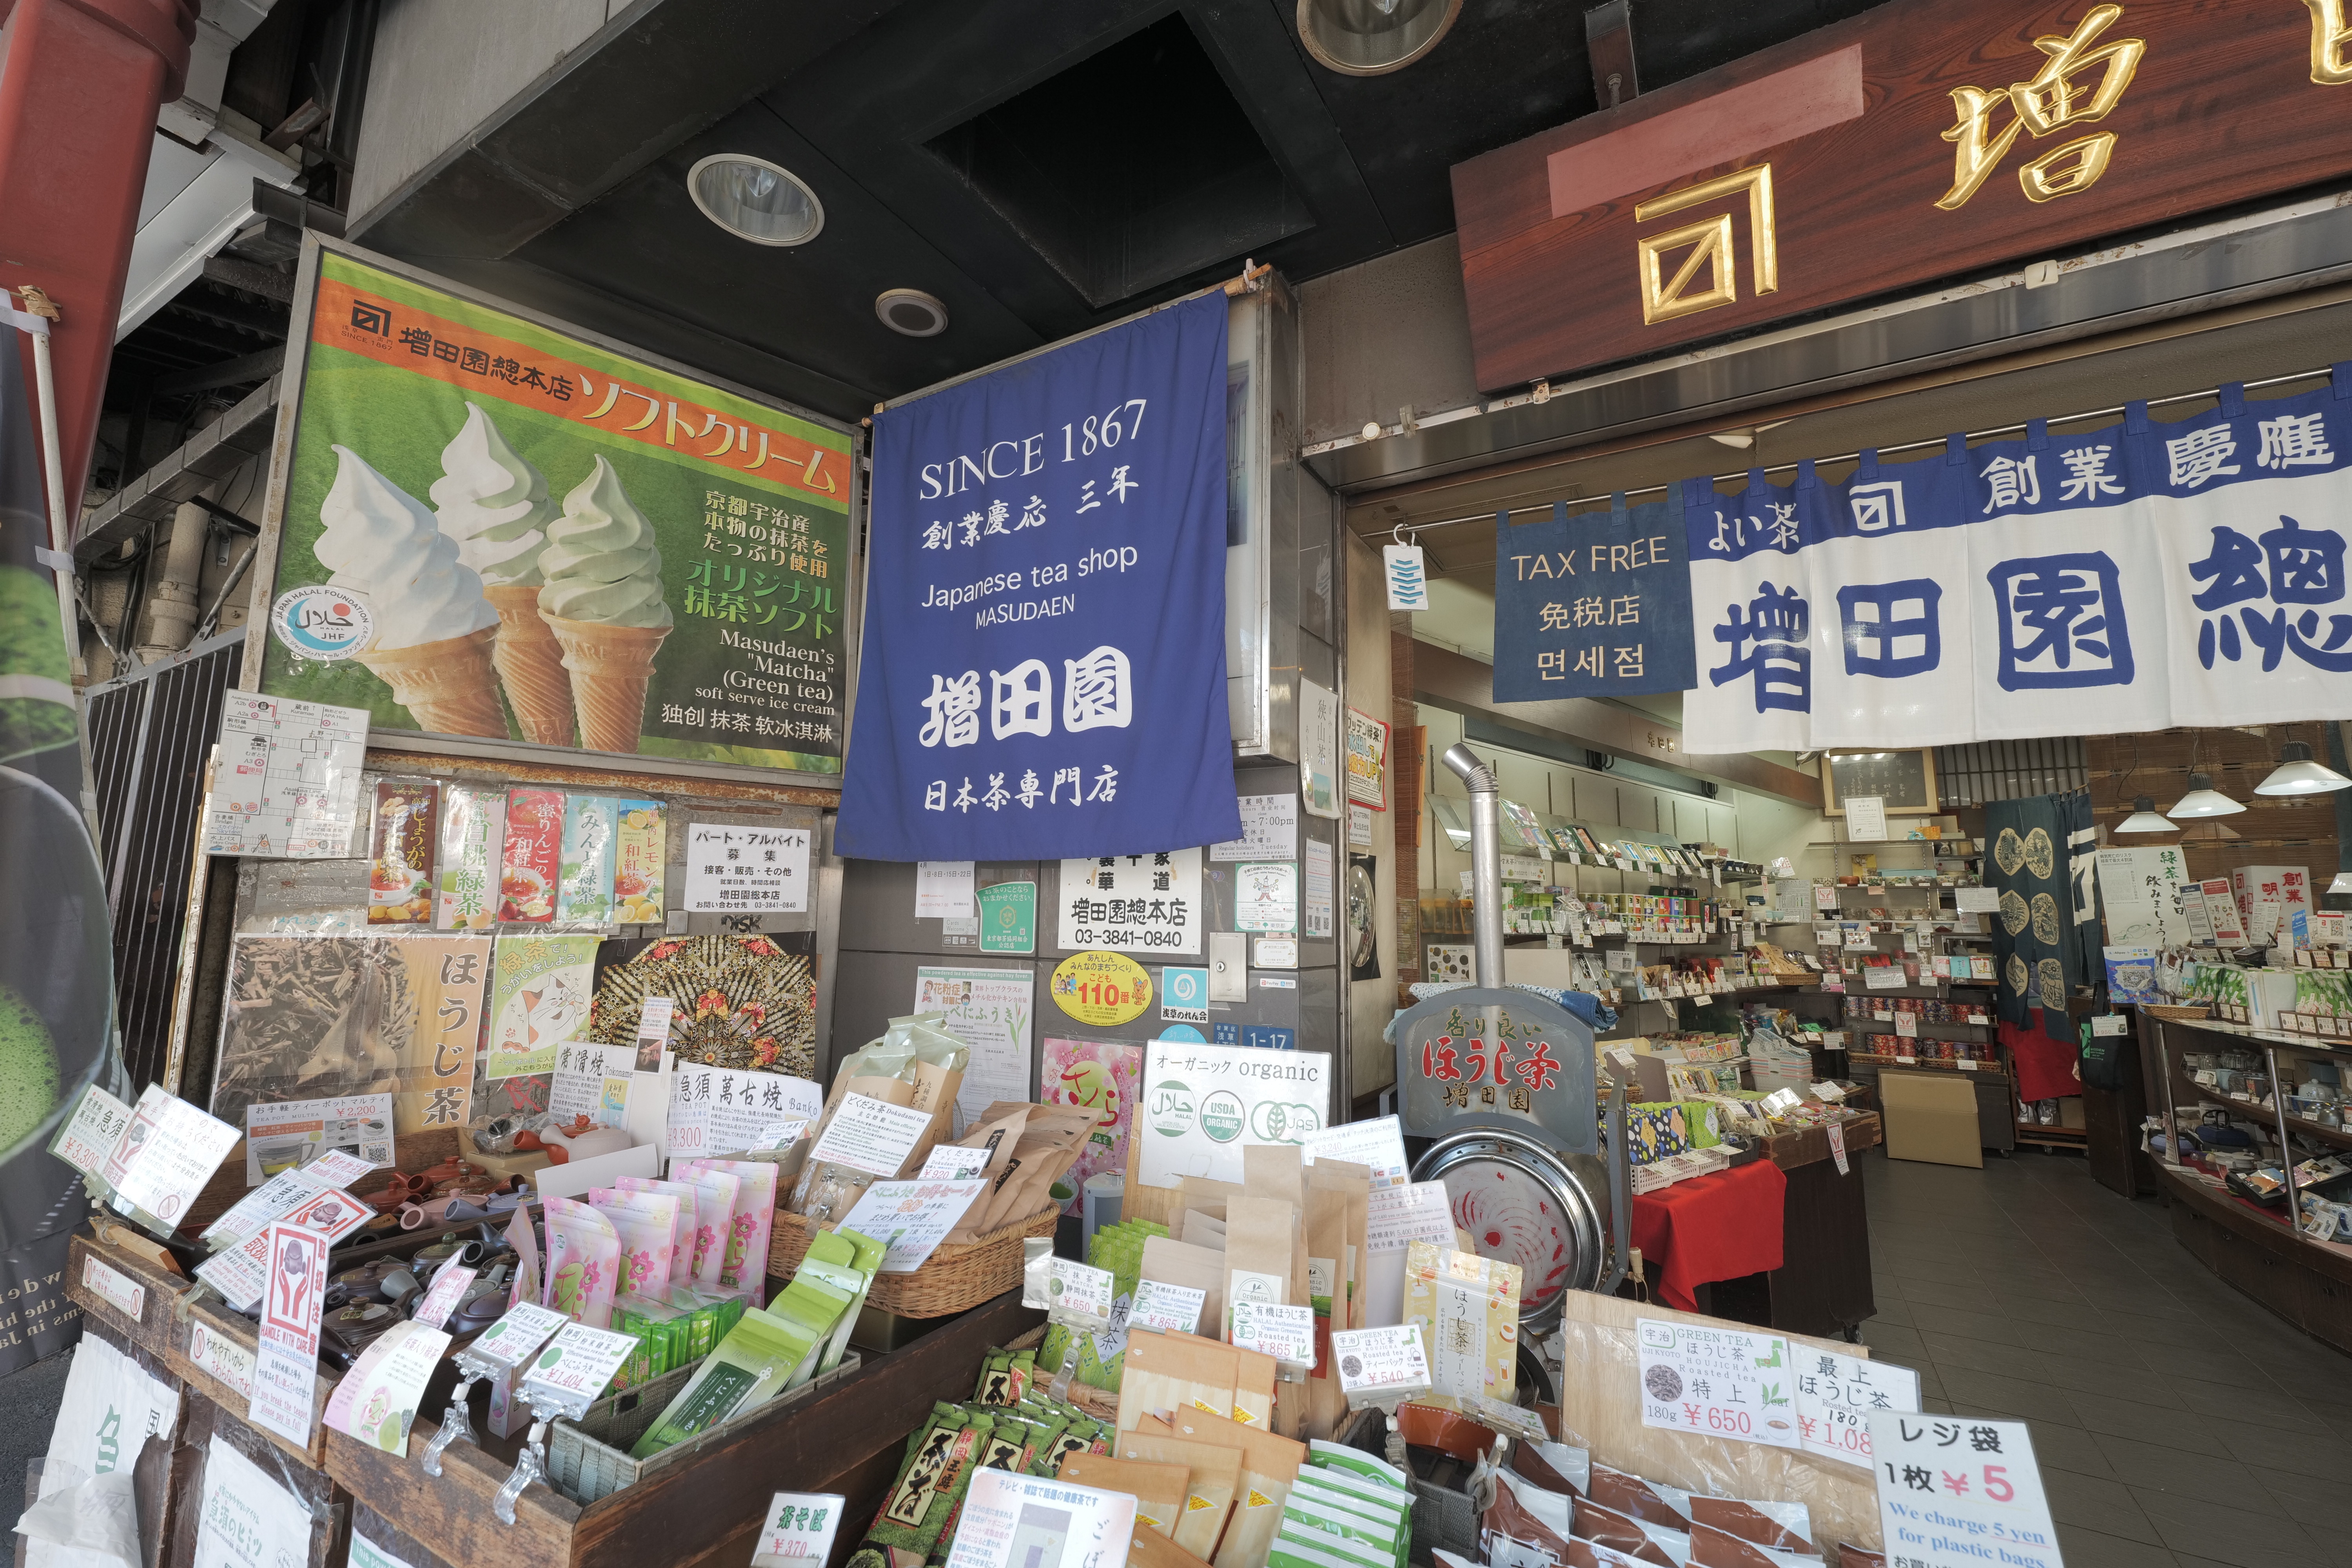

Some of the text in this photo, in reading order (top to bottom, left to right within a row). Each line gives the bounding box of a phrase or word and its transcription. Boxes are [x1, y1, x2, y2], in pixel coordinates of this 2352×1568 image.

[341, 330, 368, 344] SINCE
[579, 373, 838, 495] ソフトクリーム
[919, 398, 1147, 501] SINCE 1867
[705, 490, 810, 534] 京都宇治産
[704, 511, 828, 559] 本物の抹茶を
[1707, 500, 1800, 554] よい茶
[703, 532, 828, 579] たっぷり使用
[1510, 535, 1670, 584] TAX FREE
[686, 559, 837, 614] オリジナル
[921, 544, 1138, 611] Japanese tea shop
[325, 590, 369, 623] FOUNDATION
[684, 585, 833, 639] 抹茶ソフト
[975, 593, 1075, 630] MASUDAEN
[1537, 594, 1642, 632] 免税店
[1537, 641, 1646, 683] 면세점
[723, 670, 833, 703] (Green tea)
[695, 686, 835, 716] soft serve ice cream
[661, 703, 704, 728] 独创
[710, 709, 751, 733] 抹茶
[923, 763, 1119, 815] 日本茶専門店
[695, 830, 805, 848] パート・アルバイト
[704, 865, 792, 877] 接客・販売・その他
[982, 894, 1033, 902] おまかせください。
[984, 885, 1028, 894] お茶のことなら
[1075, 929, 1182, 947] 03-3841-0840
[1070, 962, 1132, 973] みんなのまちづくり
[1087, 954, 1115, 963] あんしん
[1089, 974, 1112, 983] こども
[1078, 982, 1129, 1006] 110番
[1162, 1008, 1207, 1022] 浅草のれん会
[1445, 1007, 1542, 1041] 香り良い
[421, 952, 480, 1128] ほうじ茶
[1218, 1032, 1234, 1041] 浅草
[605, 1066, 633, 1078] Tokoname
[1157, 1055, 1231, 1074] オーガニック
[1239, 1061, 1318, 1082] organic
[1421, 1035, 1561, 1091] ほうじ茶
[336, 1105, 376, 1117] ¥2,200
[789, 1098, 817, 1117] Banko
[847, 1096, 886, 1114] どくだみ茶
[1210, 1102, 1235, 1115] USDA
[1207, 1117, 1238, 1129] ORGANIC
[64, 1136, 100, 1171] ¥3,300
[307, 1238, 326, 1356] 取扱注意
[1063, 1295, 1090, 1312] ¥650
[1255, 1305, 1308, 1321] 有機ほうじ茶
[1257, 1340, 1290, 1356] ¥865
[1258, 1331, 1289, 1341] Roasted
[1339, 1336, 1356, 1345] 宇治
[1365, 1337, 1394, 1346] ほうじ茶
[1677, 1328, 1755, 1348] GREEN TEA
[1363, 1350, 1390, 1359] Roasted
[1686, 1341, 1746, 1361] ほうじ茶
[1367, 1370, 1403, 1385] ¥540
[1798, 1374, 1892, 1411] ほうじ茶
[1647, 1405, 1677, 1423] 180g
[1682, 1402, 1751, 1435] ¥650
[1900, 1419, 2003, 1454] レジ袋
[1885, 1462, 2014, 1502] 1枚 ¥5
[777, 1504, 828, 1532] 茶そば
[1888, 1501, 2046, 1545] We charge 5 yen
[1897, 1527, 1926, 1544] for
[1931, 1535, 1993, 1559] plastic
